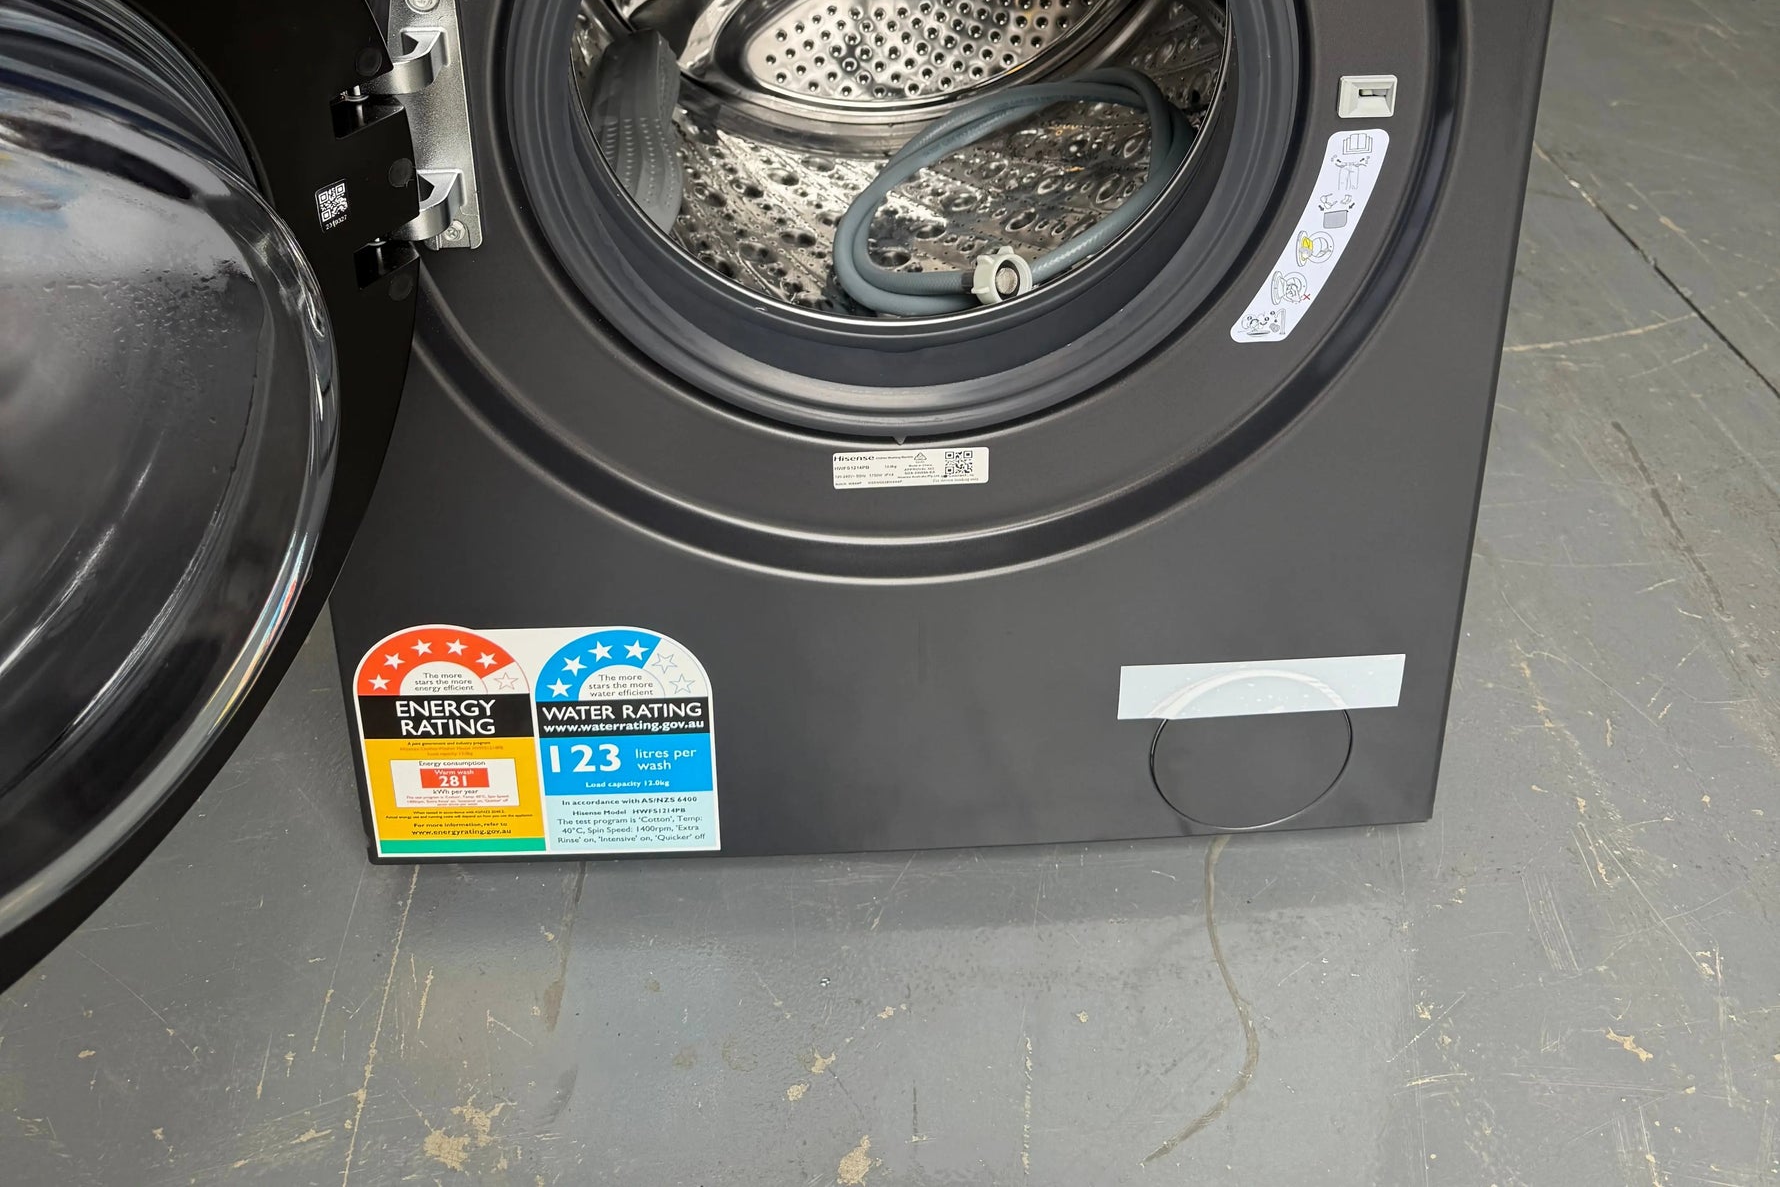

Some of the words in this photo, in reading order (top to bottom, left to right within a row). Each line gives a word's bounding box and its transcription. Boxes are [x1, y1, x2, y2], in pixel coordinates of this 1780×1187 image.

[415, 685, 440, 693] energy
[395, 699, 496, 717] ENERGY
[541, 705, 615, 722] WATER
[622, 702, 702, 719] RATING
[400, 718, 496, 736] RATING
[543, 719, 704, 733] www.waterrating.gov.au
[549, 743, 622, 773] 123
[635, 748, 669, 759] litres
[674, 748, 696, 760] per
[637, 759, 671, 771] wash
[439, 775, 468, 787] 281
[608, 780, 641, 788] capacity
[593, 817, 628, 826] program
[677, 815, 703, 823] Temp:
[411, 828, 512, 836] www.energyrating.gov.au
[587, 826, 604, 835] Spin
[606, 826, 633, 834] Speed:
[636, 825, 674, 833] 1400rpm,
